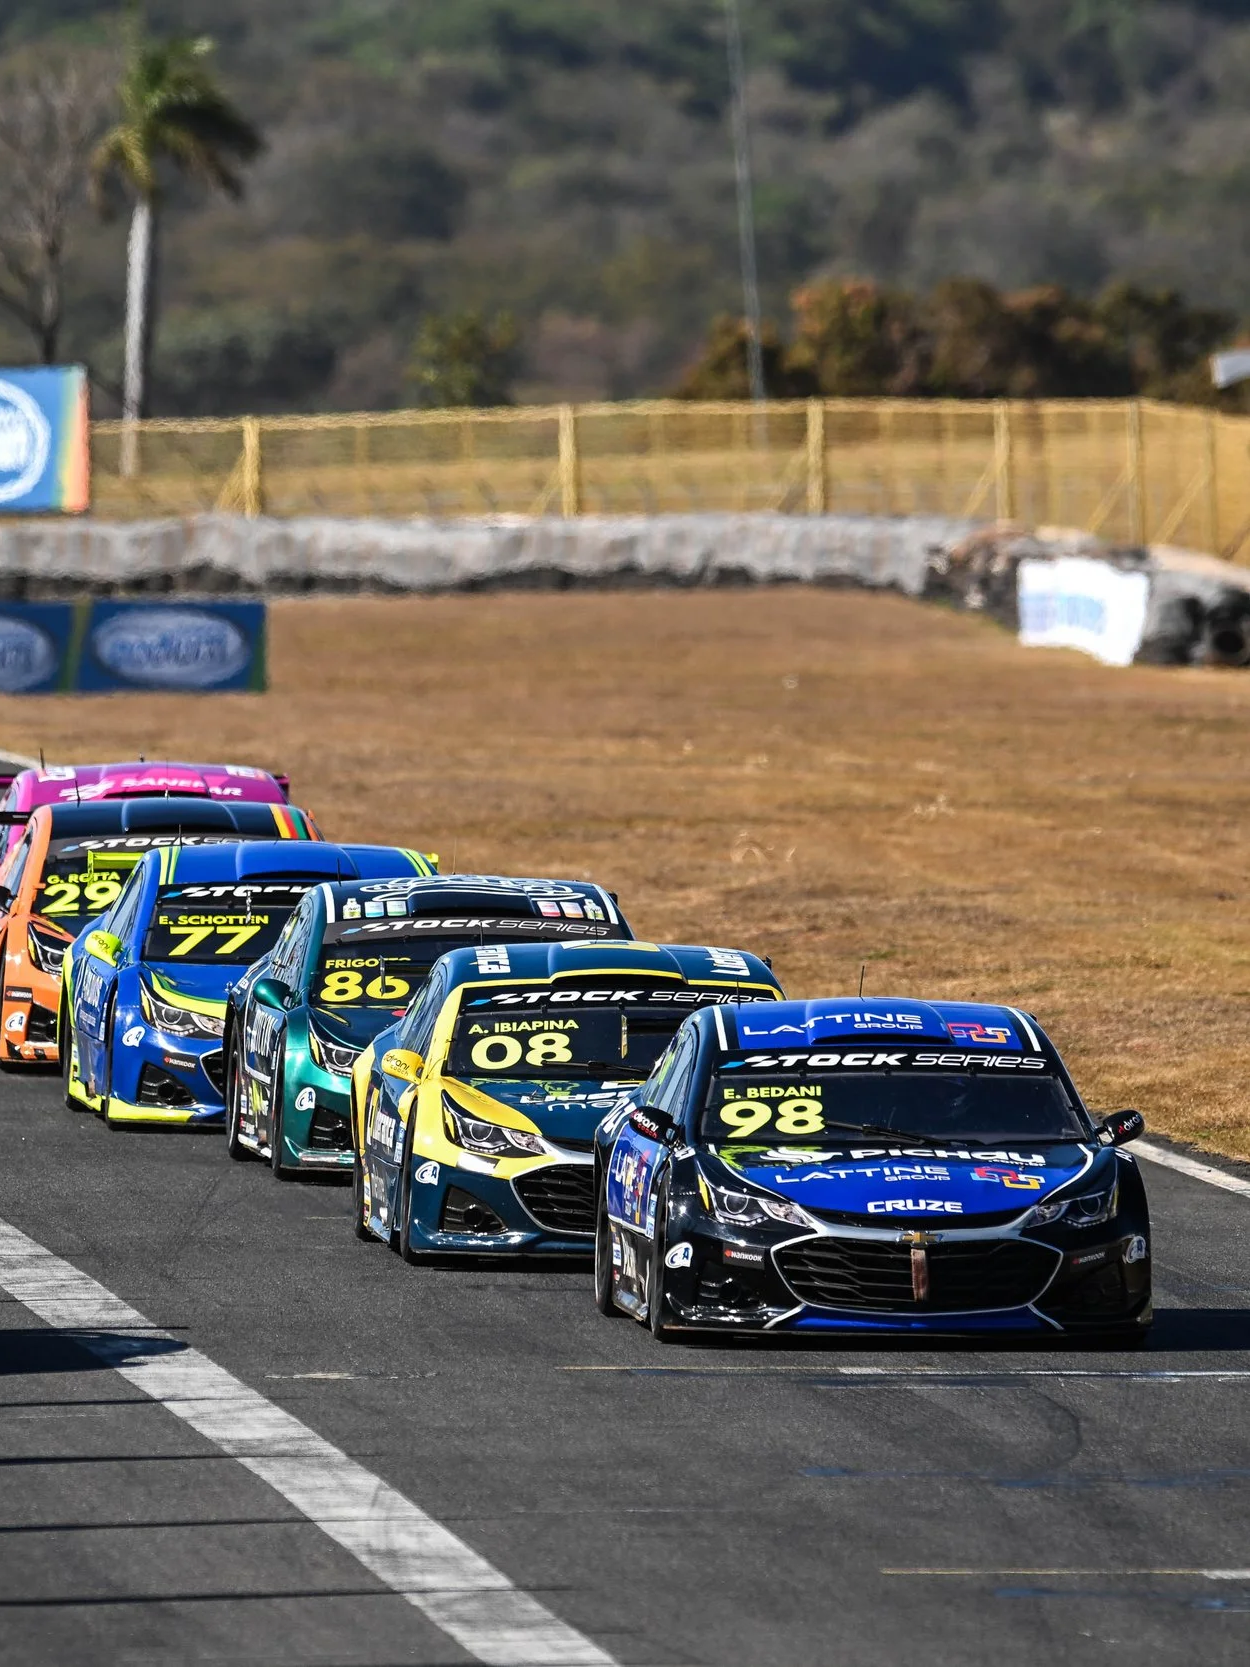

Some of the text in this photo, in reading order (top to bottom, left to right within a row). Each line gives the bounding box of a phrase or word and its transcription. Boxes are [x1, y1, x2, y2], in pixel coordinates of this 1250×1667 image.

[78, 836, 201, 854] STOCK
[47, 876, 64, 884] G.
[41, 881, 124, 914] 29
[158, 915, 270, 925] E. SCHOTTEN
[361, 918, 610, 936] STOCK SERIES
[168, 926, 262, 957] 77
[320, 970, 410, 1002] 86
[491, 990, 645, 1005] STOCK
[468, 1019, 579, 1035] A. IBIAPINA
[743, 1013, 922, 1036] LATTINE
[853, 1022, 924, 1030] GROUP
[470, 1033, 573, 1070] 08
[744, 1053, 1047, 1069] STOCK SERIES
[723, 1085, 822, 1100] E. BEDANI
[719, 1098, 826, 1138] 98
[775, 1165, 949, 1184] LATTINE
[884, 1174, 950, 1182] GROUP
[867, 1199, 963, 1213] CRUZE
